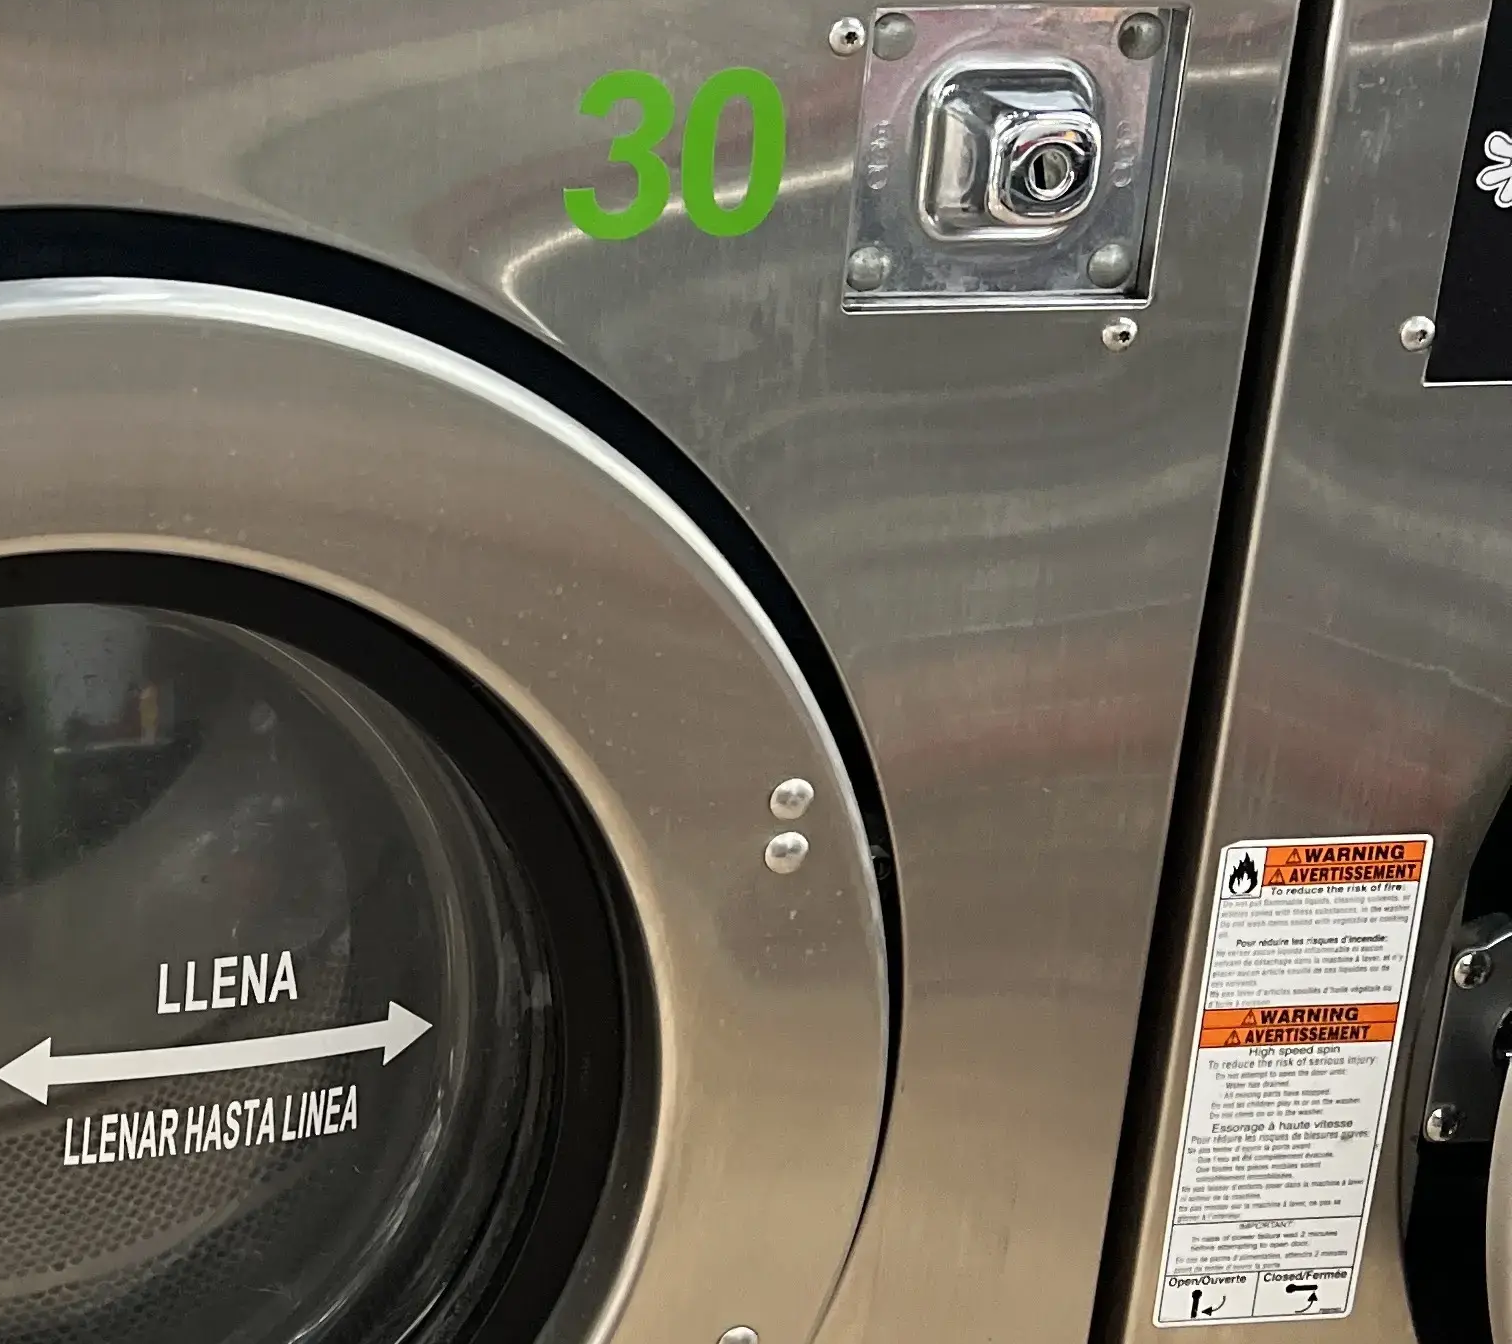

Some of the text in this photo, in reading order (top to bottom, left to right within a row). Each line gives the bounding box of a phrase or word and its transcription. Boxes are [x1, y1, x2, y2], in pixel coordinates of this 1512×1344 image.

[562, 66, 786, 240] 30
[1305, 845, 1405, 862] WARNING
[1289, 864, 1416, 882] AVERTISSEMENT
[1271, 887, 1283, 895] To
[1286, 886, 1323, 895] reduce
[1327, 885, 1344, 893] the
[1347, 885, 1367, 893] risk
[1371, 883, 1382, 892] of
[157, 952, 298, 1015] LLENA
[1261, 1007, 1359, 1024] WARNING
[1245, 1026, 1371, 1044] AVERTISSEMENT
[1249, 1044, 1341, 1057] High speed spin
[63, 1085, 358, 1167] LLENAR HASTA LINEA
[1212, 1121, 1265, 1134] Essorage
[1279, 1121, 1310, 1130] haute
[1314, 1118, 1353, 1128] vitesse
[1168, 1274, 1246, 1287] Open/Ouverte
[1264, 1269, 1347, 1282] Closed/Fermée
